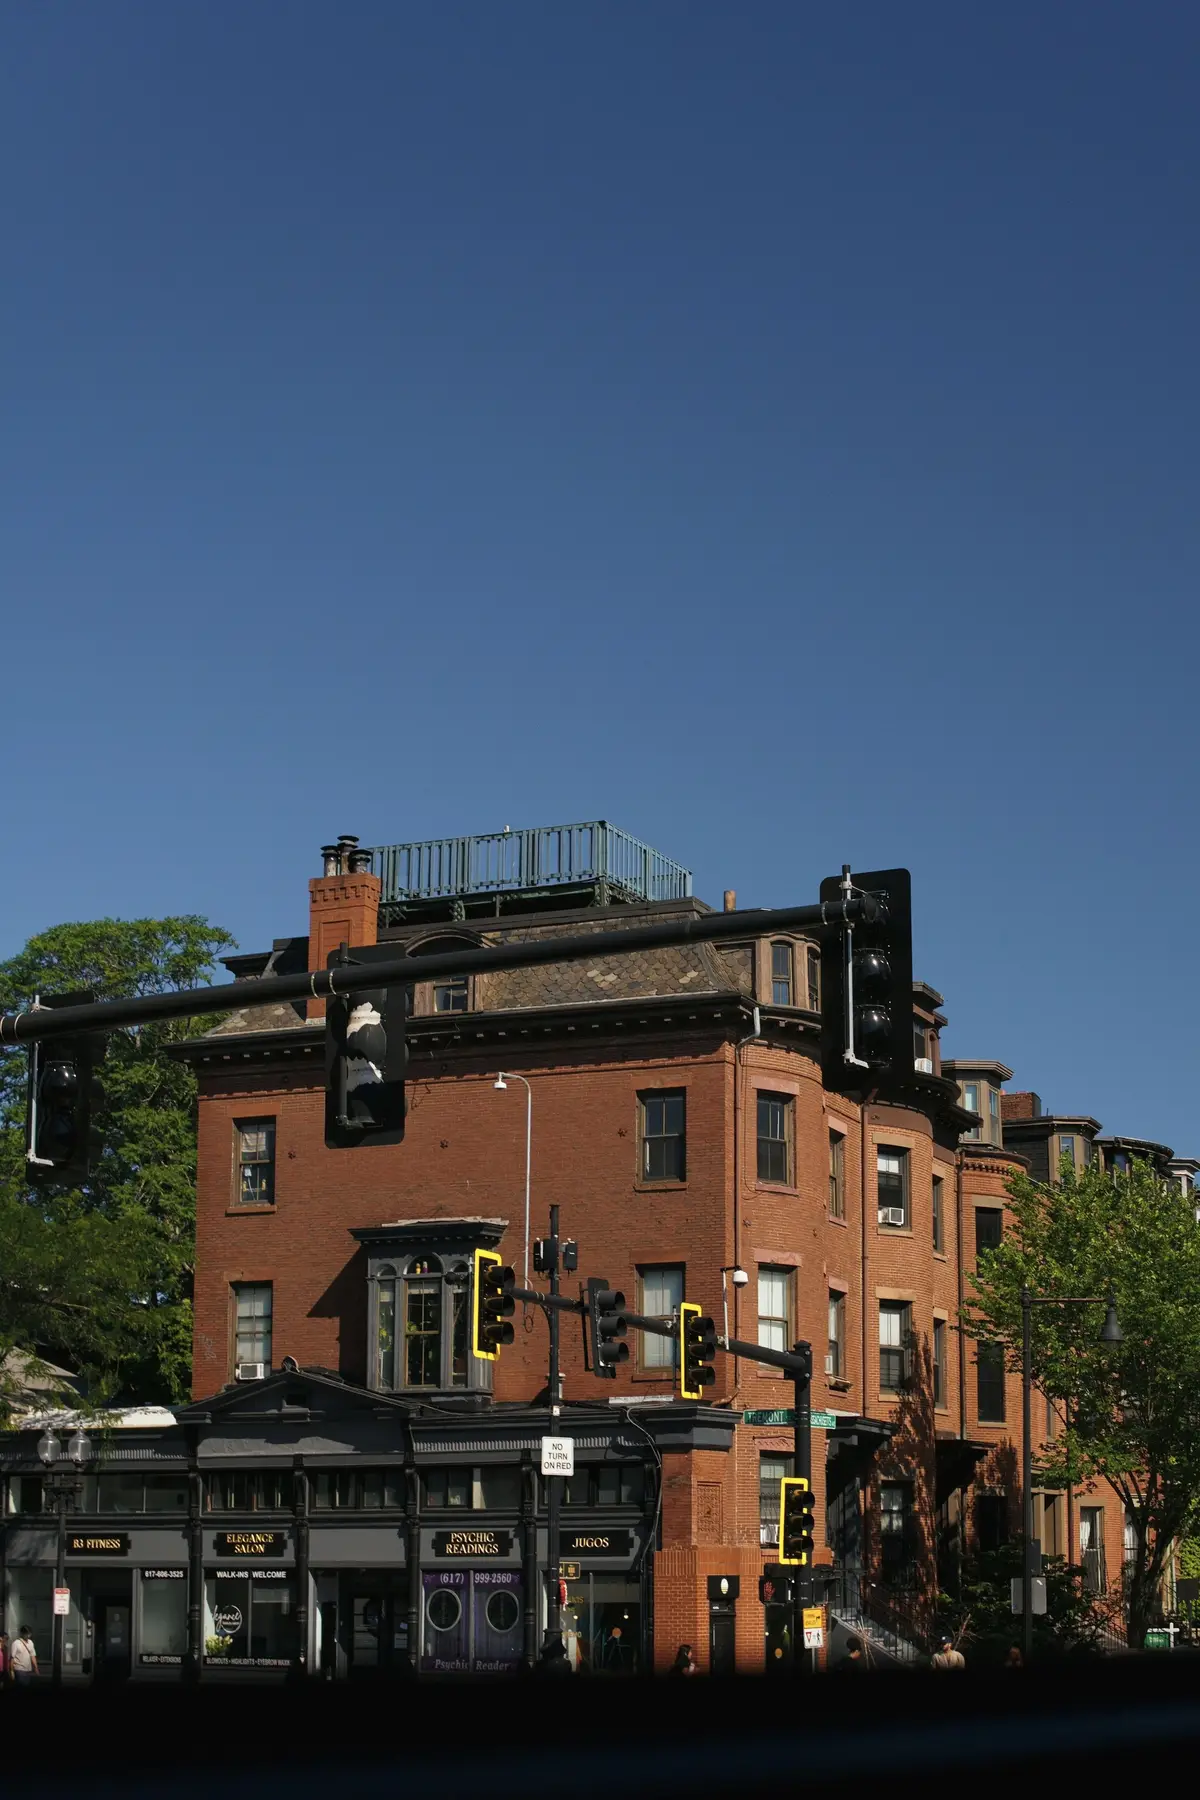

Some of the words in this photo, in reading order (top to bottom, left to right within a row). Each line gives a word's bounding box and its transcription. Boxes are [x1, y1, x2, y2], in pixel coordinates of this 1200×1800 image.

[748, 1411, 784, 1422] TREMONT
[552, 1443, 563, 1451] NO
[548, 1452, 568, 1460] TURN
[226, 1533, 274, 1543] ELEGANCE
[451, 1532, 494, 1543] PSYCHIC
[572, 1537, 609, 1548] JUGOS
[86, 1538, 121, 1549] FITNESS
[234, 1544, 265, 1554] SALON
[445, 1543, 499, 1554] READINGS
[216, 1570, 249, 1578] WALK-INS
[252, 1570, 287, 1578] WELCOME
[440, 1572, 465, 1584] (617)
[474, 1572, 512, 1584] 999-2560
[435, 1658, 468, 1671] Psychic
[475, 1659, 510, 1671] Reader
